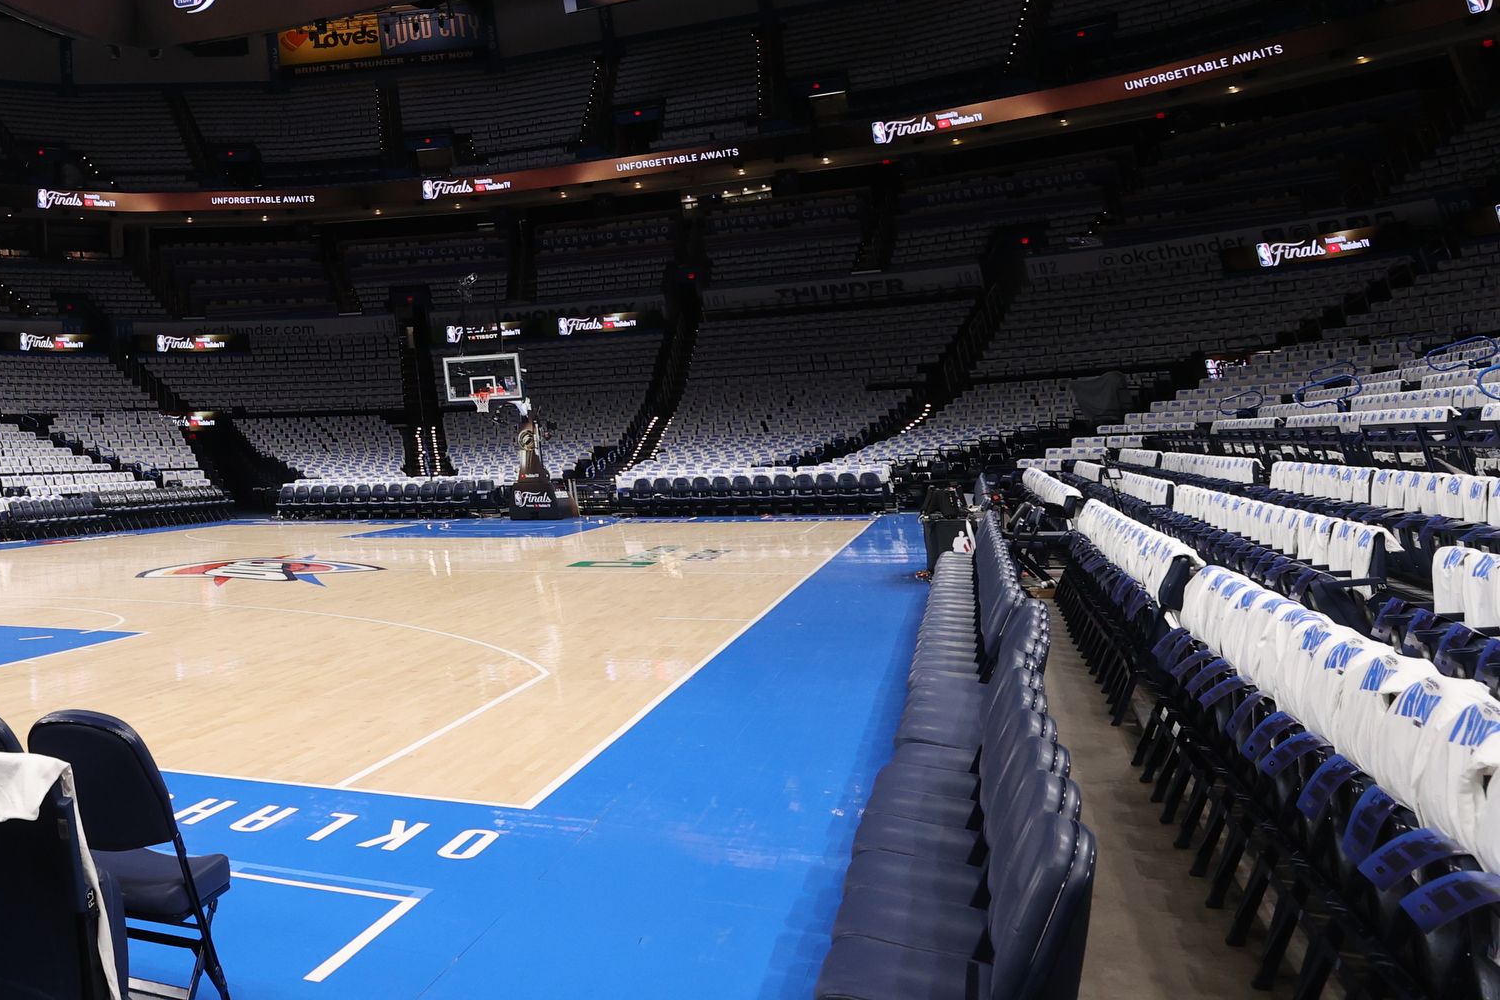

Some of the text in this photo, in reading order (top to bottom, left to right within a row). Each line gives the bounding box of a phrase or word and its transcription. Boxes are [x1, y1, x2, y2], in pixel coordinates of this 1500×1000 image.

[1124, 43, 1283, 92] UNFORGETTABLE AWAITS
[885, 115, 935, 143] Finals
[616, 147, 740, 172] UNFORGETTABLE AWAITS
[45, 190, 83, 208] Finals
[211, 194, 315, 206] UNFORGETTABLE AWAITS
[432, 178, 473, 199] Finals
[1102, 235, 1245, 266] @okcthunder
[1270, 240, 1326, 266] Finals
[568, 316, 602, 335] Finals
[27, 335, 54, 349] Finals
[164, 336, 194, 351] Finals
[174, 797, 500, 860] OKLAH
